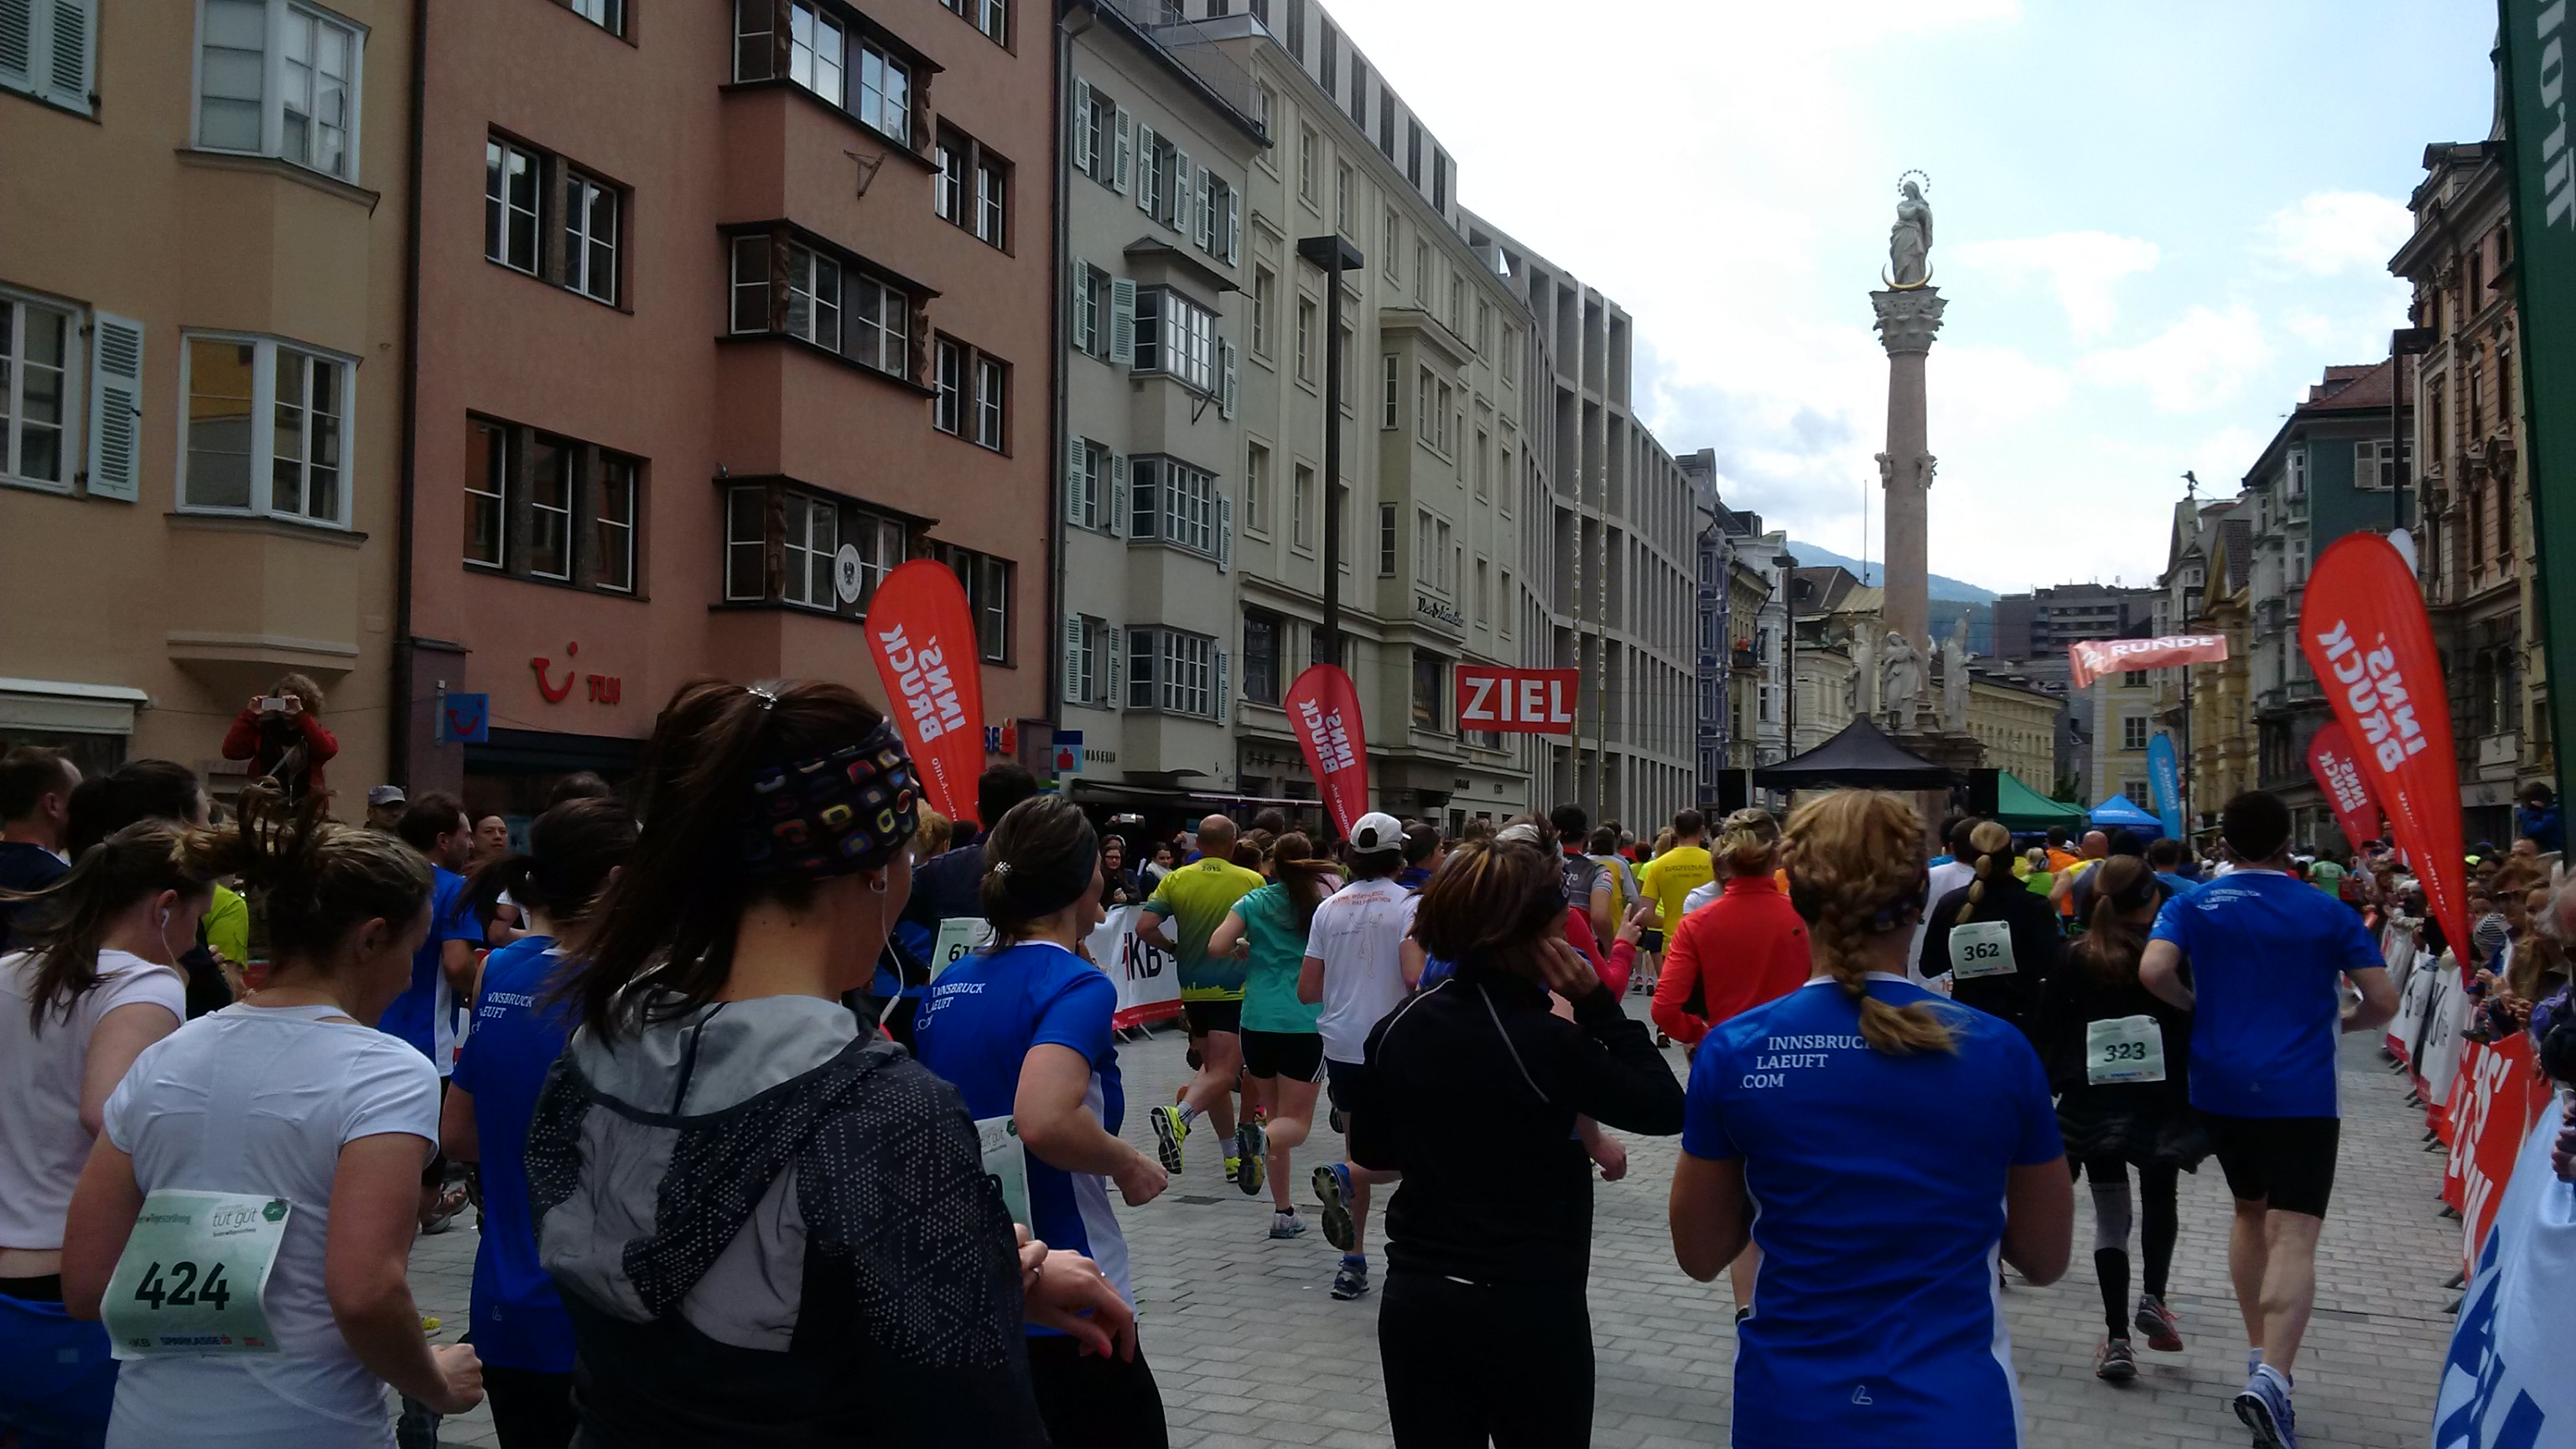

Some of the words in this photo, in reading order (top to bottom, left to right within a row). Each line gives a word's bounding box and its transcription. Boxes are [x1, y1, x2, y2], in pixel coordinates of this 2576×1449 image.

[2111, 637, 2215, 657] RUNDE
[588, 674, 621, 704] TUI
[1462, 678, 1571, 723] ZIEL
[1964, 943, 2000, 962] 362
[1755, 1053, 1829, 1070] LAEUFT
[2103, 1041, 2146, 1062] 323
[1739, 1072, 1785, 1089] .COM
[213, 1212, 234, 1228] tut
[234, 1208, 258, 1228] gut
[134, 1261, 231, 1311] 424
